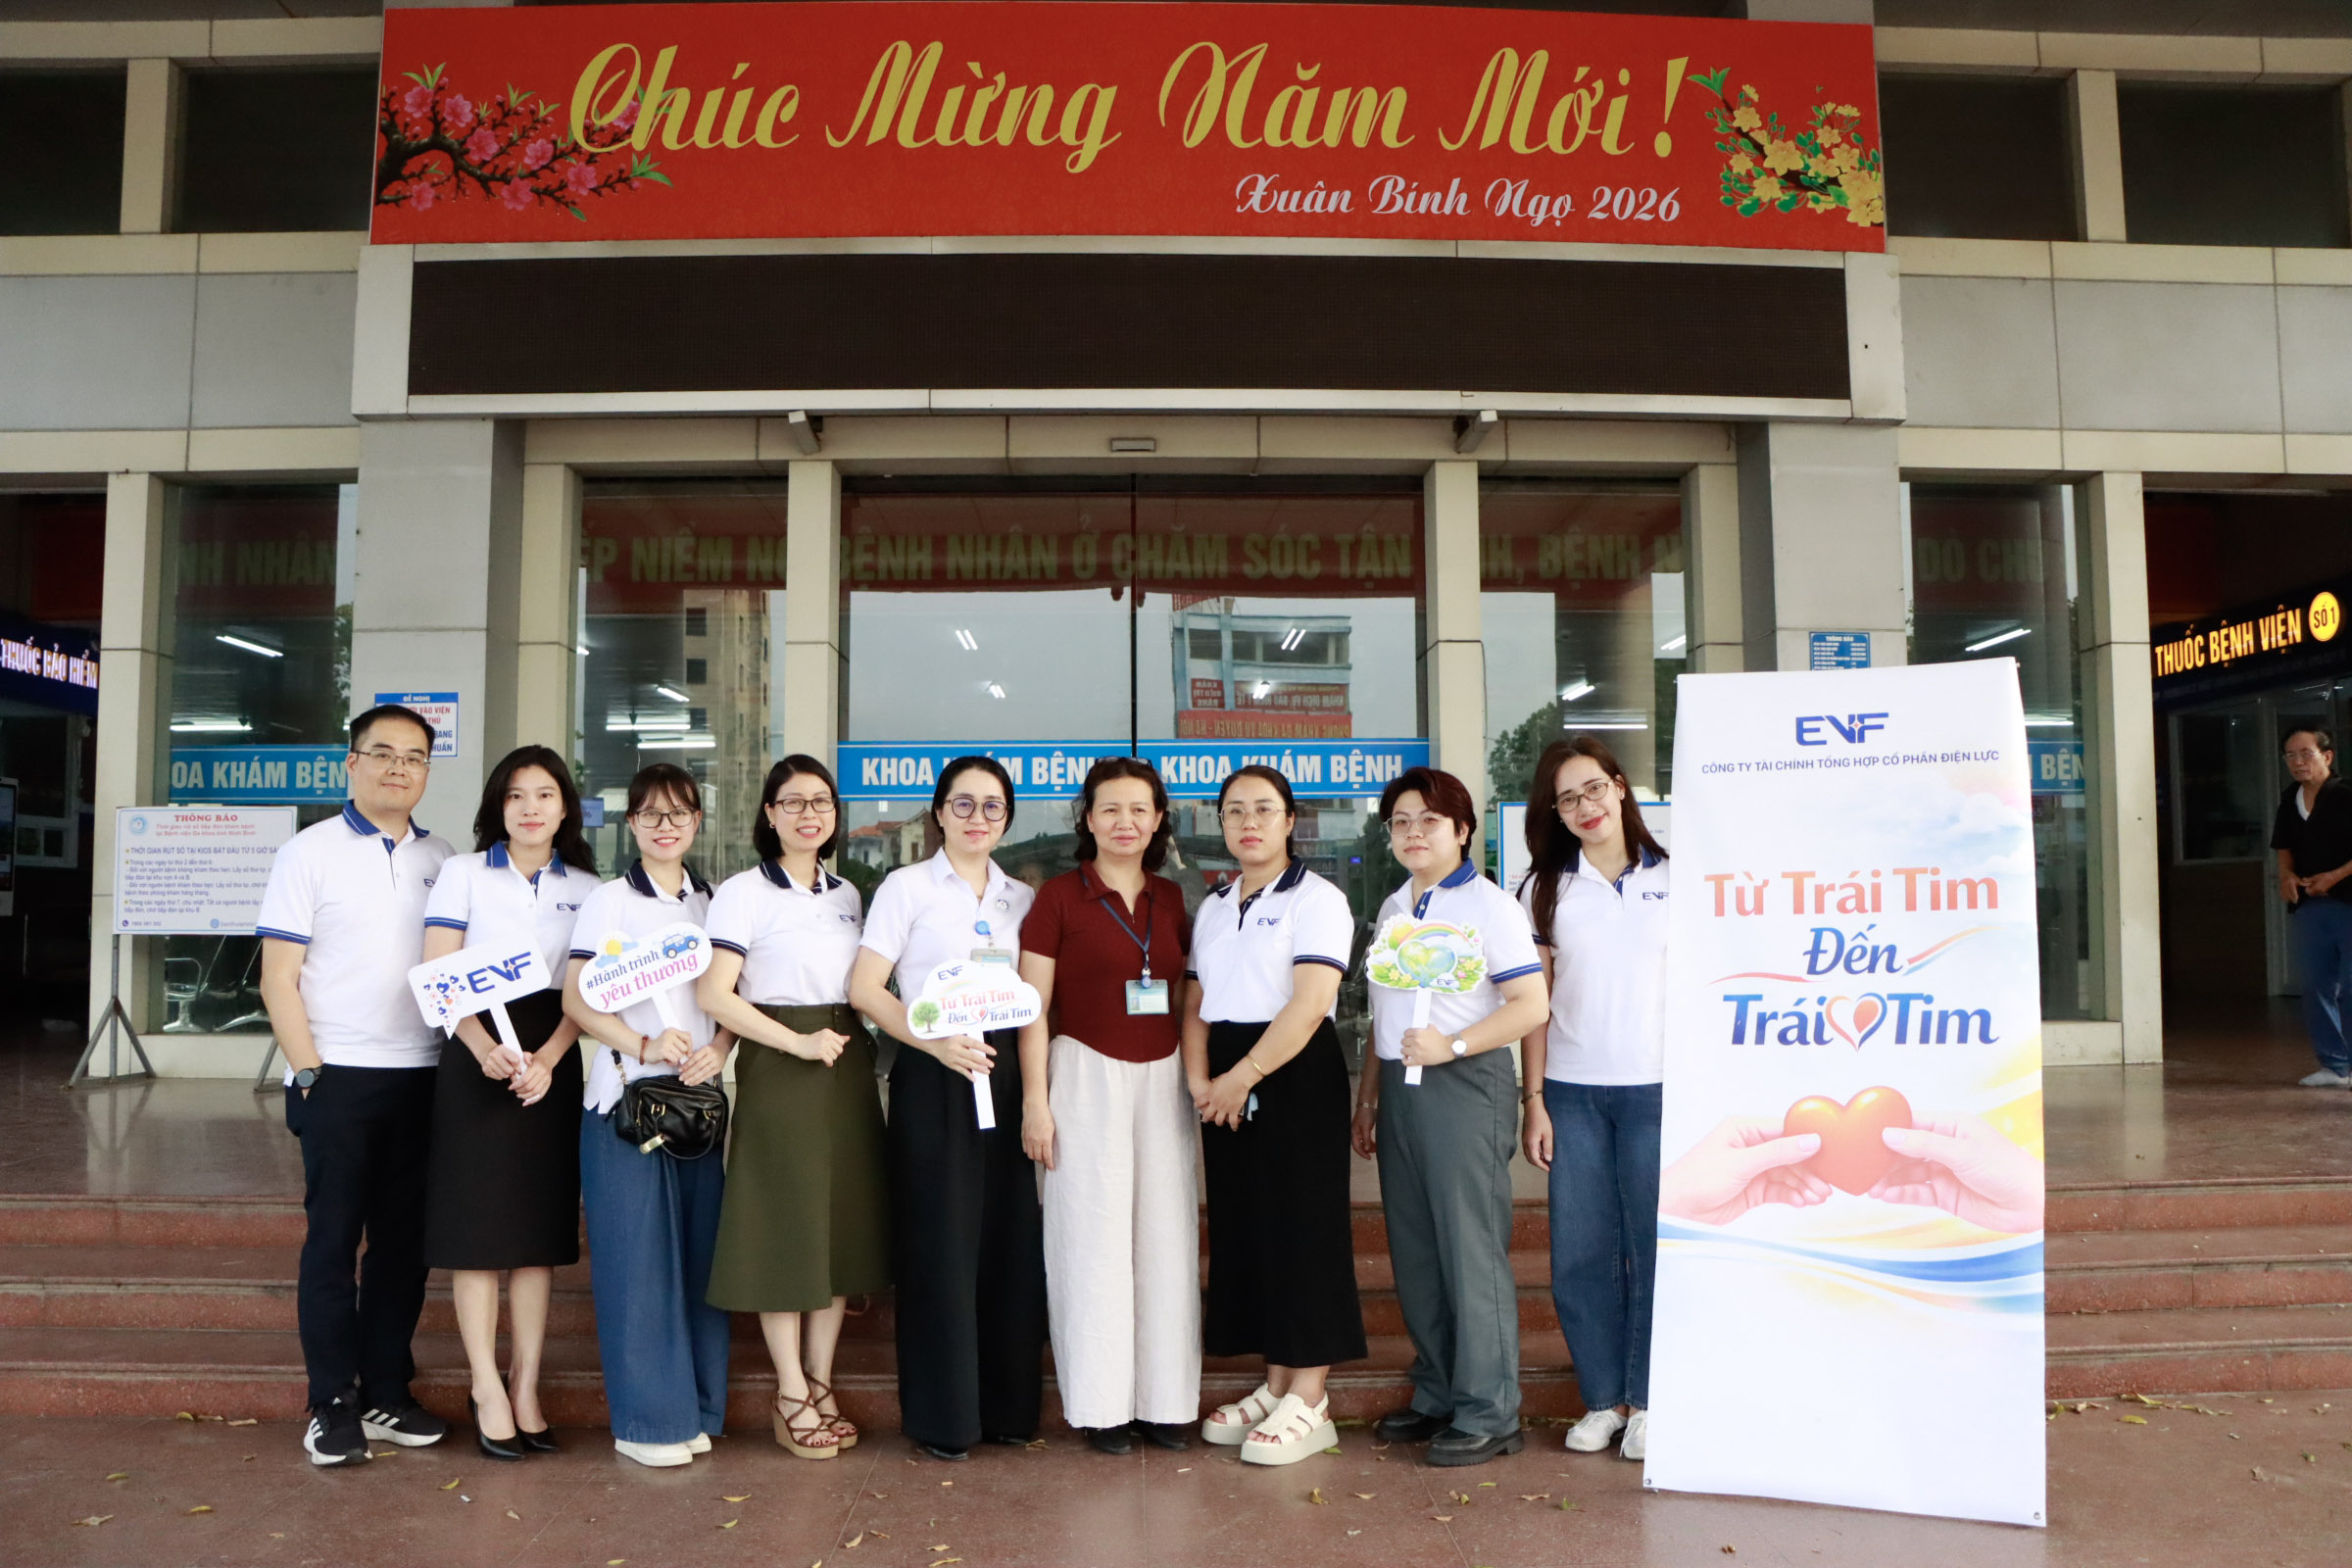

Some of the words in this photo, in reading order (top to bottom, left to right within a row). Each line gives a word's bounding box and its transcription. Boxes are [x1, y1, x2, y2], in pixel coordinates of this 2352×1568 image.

[570, 42, 799, 153] Chúc
[826, 40, 1122, 174] Mừng
[1158, 41, 1415, 150] Năm
[1235, 173, 1354, 215] Xuân
[1368, 174, 1469, 217] Bính
[1484, 177, 1575, 227] Ngọ
[1588, 185, 1681, 222] 2026
[946, 523, 1058, 581] NHÂN
[1110, 523, 1226, 580] CHĂM
[1242, 523, 1322, 580] SÓC
[1334, 521, 1412, 590] TẬN
[2313, 601, 2328, 629] SỐ
[2154, 623, 2206, 677] THUỐC
[2208, 619, 2255, 668] BỆNH
[2258, 604, 2302, 655] VIỆN
[1795, 711, 1889, 747] EVF
[172, 760, 205, 789] OA
[212, 756, 287, 789] KHÁM
[862, 757, 934, 786] KHOA
[1160, 755, 1232, 784] KHOA
[1330, 749, 1402, 789] BỆNH
[1701, 761, 1735, 774] CÔNG
[1736, 761, 1752, 772] TY
[1754, 759, 1773, 771] TÀI
[1775, 758, 1815, 770] CHÍNH
[1817, 755, 1850, 768] TỔNG
[1853, 756, 1880, 768] HỢP
[1882, 752, 1900, 765] CỔ
[1940, 751, 1971, 764] ĐIỆN
[1974, 750, 2000, 763] LỰC
[174, 813, 212, 822] THÔNG
[216, 813, 238, 822] BÁO
[1703, 870, 1770, 917] Từ
[1781, 869, 1882, 915] Trái
[1892, 866, 1999, 912] Tim
[1802, 923, 1904, 976] Đến
[466, 951, 532, 994] EVF
[586, 963, 628, 990] #Hành
[628, 950, 660, 971] trình
[600, 983, 633, 1009] yêu
[634, 953, 698, 991] thương
[938, 965, 964, 981] EVF
[940, 996, 957, 1010] Từ
[961, 991, 987, 1007] Trái
[987, 989, 1015, 1003] Tim
[1722, 994, 1835, 1046] Trái
[1886, 993, 2001, 1046] Tim
